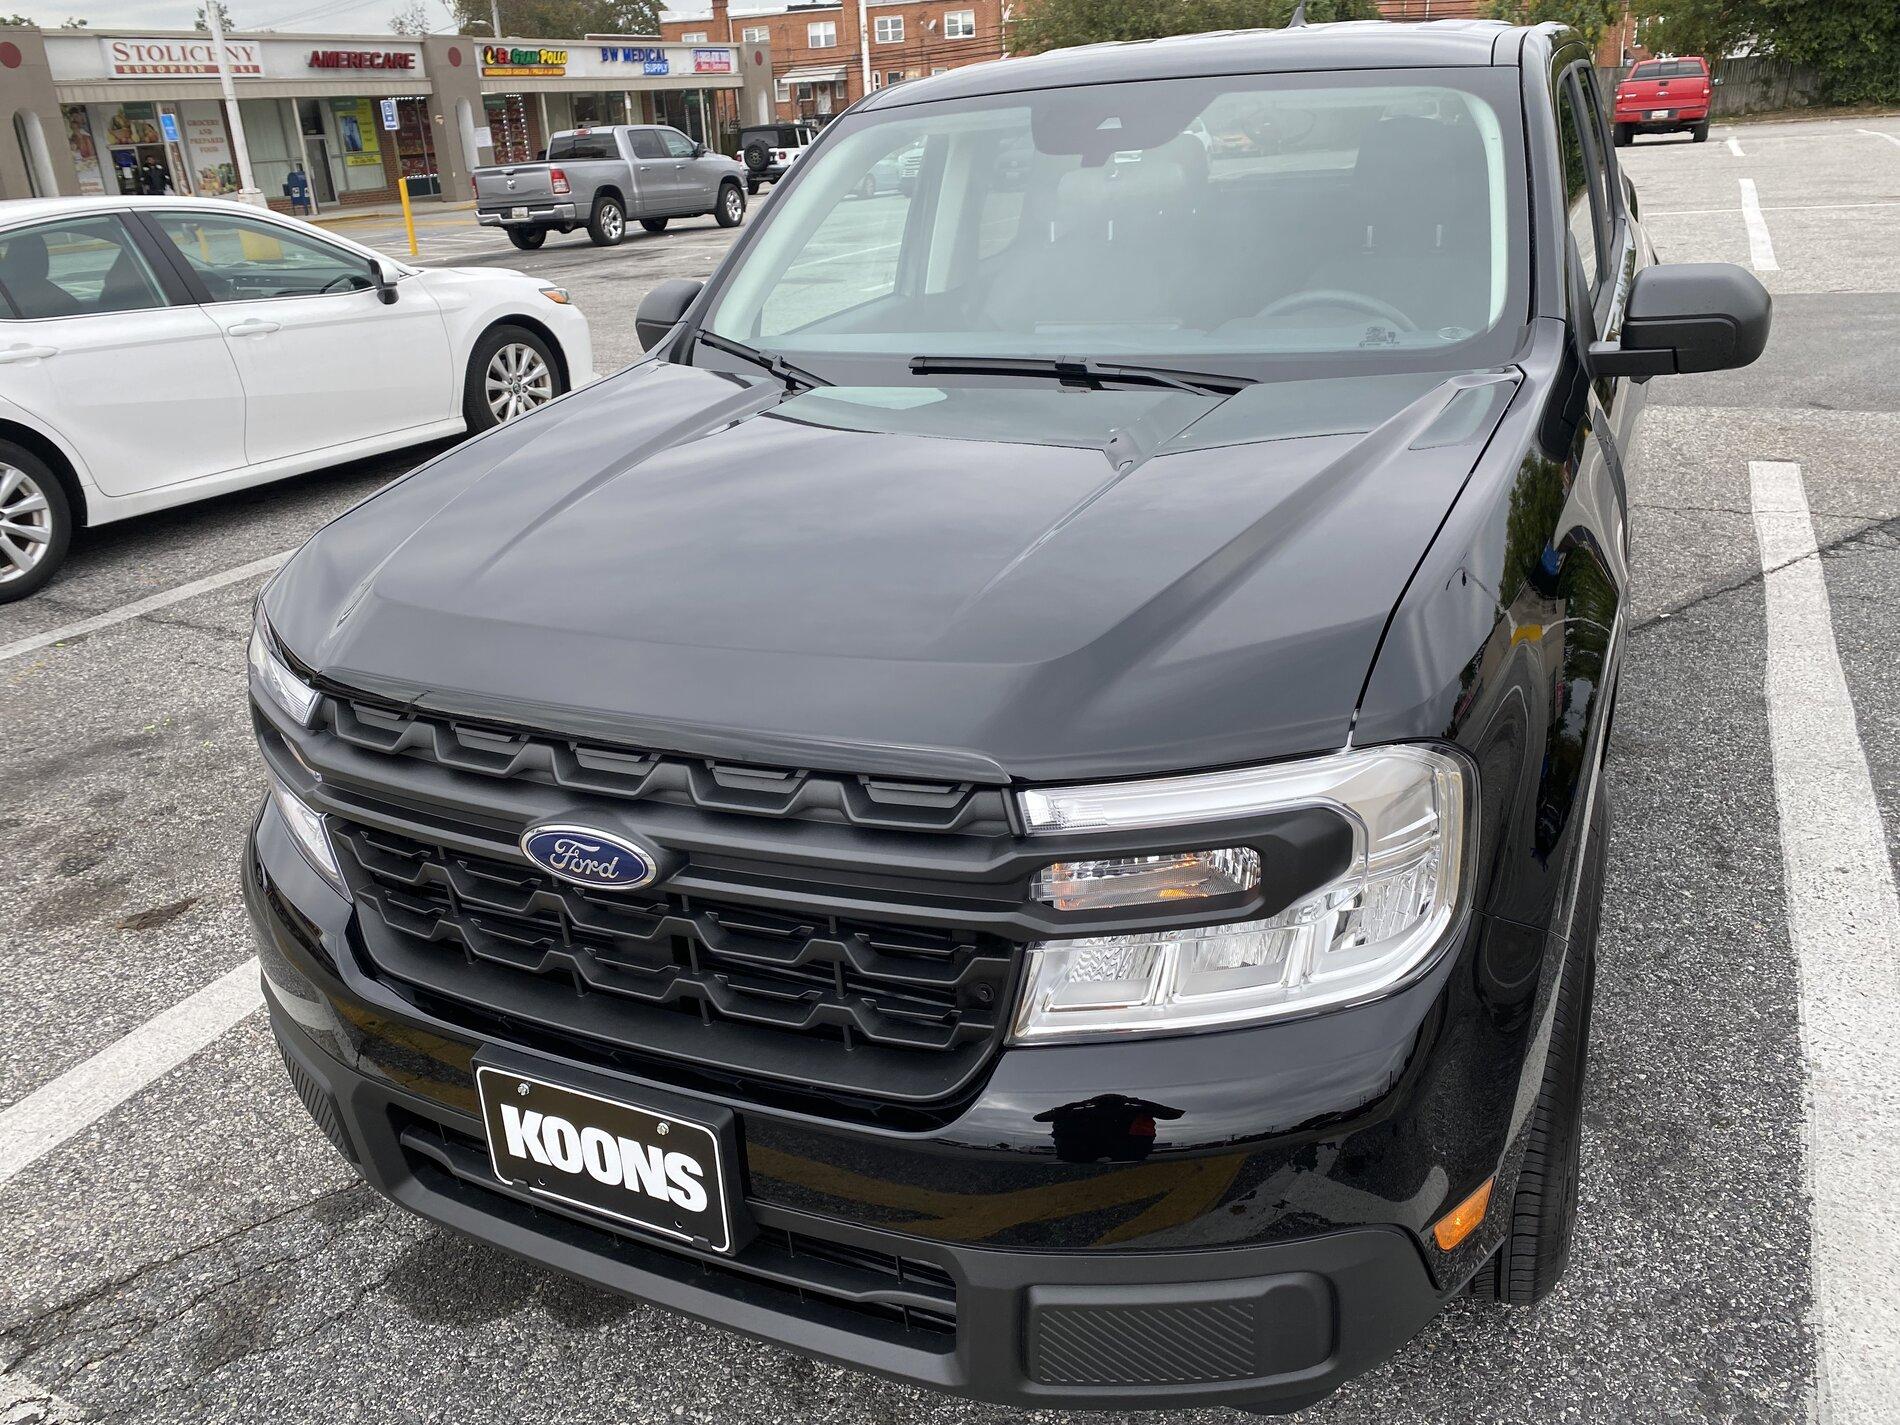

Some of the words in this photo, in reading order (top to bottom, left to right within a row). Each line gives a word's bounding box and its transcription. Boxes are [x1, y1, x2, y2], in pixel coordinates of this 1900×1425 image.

[308, 50, 416, 70] AMERECARE
[538, 48, 568, 65] POLLO
[601, 47, 619, 62] BW
[622, 48, 668, 62] MEDICAL
[122, 64, 206, 74] EUROPEAN
[645, 62, 669, 75] SUPPLY
[549, 837, 619, 881] Ford
[500, 1103, 708, 1212] KOONS
